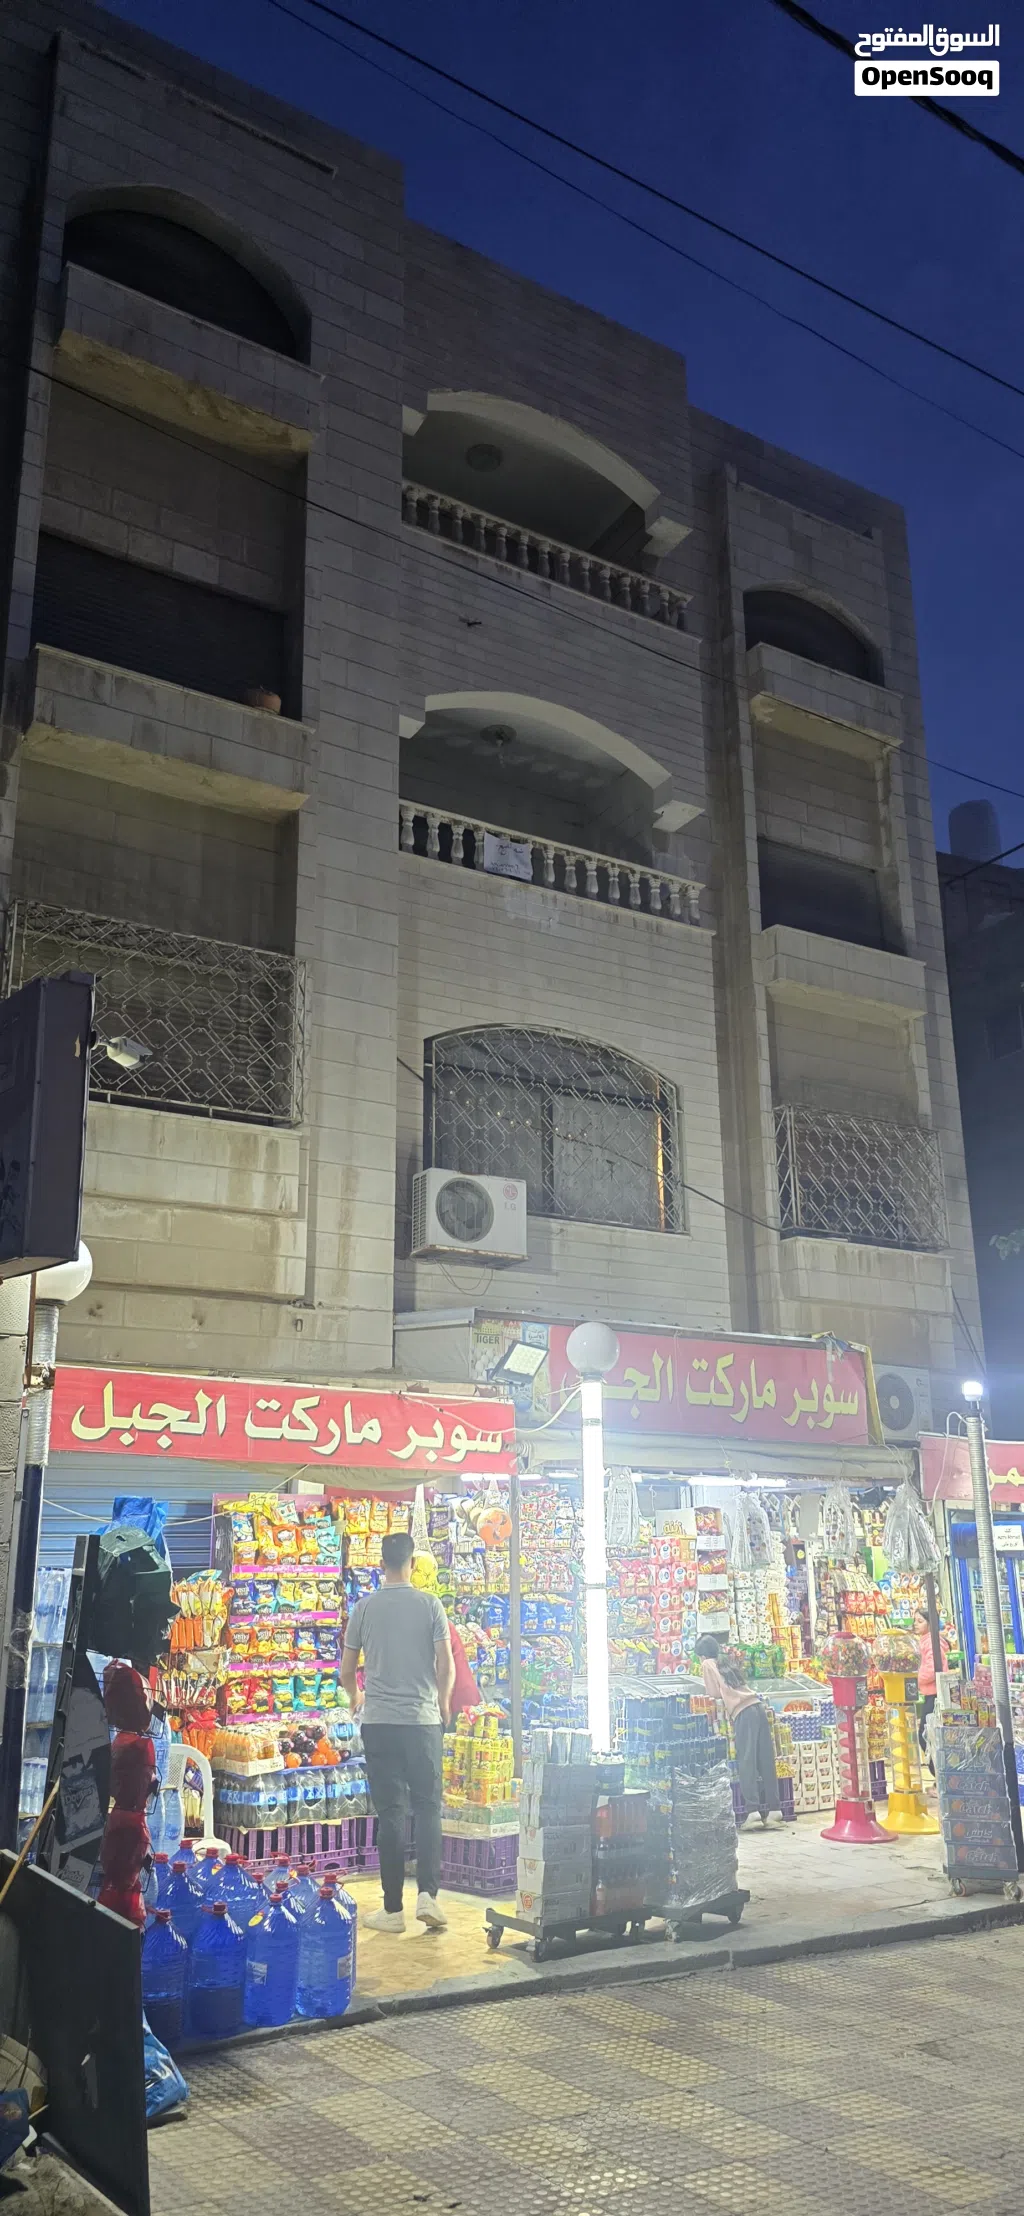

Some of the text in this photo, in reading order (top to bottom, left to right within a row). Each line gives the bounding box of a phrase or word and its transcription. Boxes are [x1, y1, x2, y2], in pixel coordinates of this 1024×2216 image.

[503, 1201, 517, 1212] LG
[476, 1333, 500, 1345] TIGER
[561, 1349, 859, 1430] سوبر ماركت الج
[71, 1380, 504, 1463] سوبر ماركت الجبل
[64, 1787, 94, 1806] Doritos
